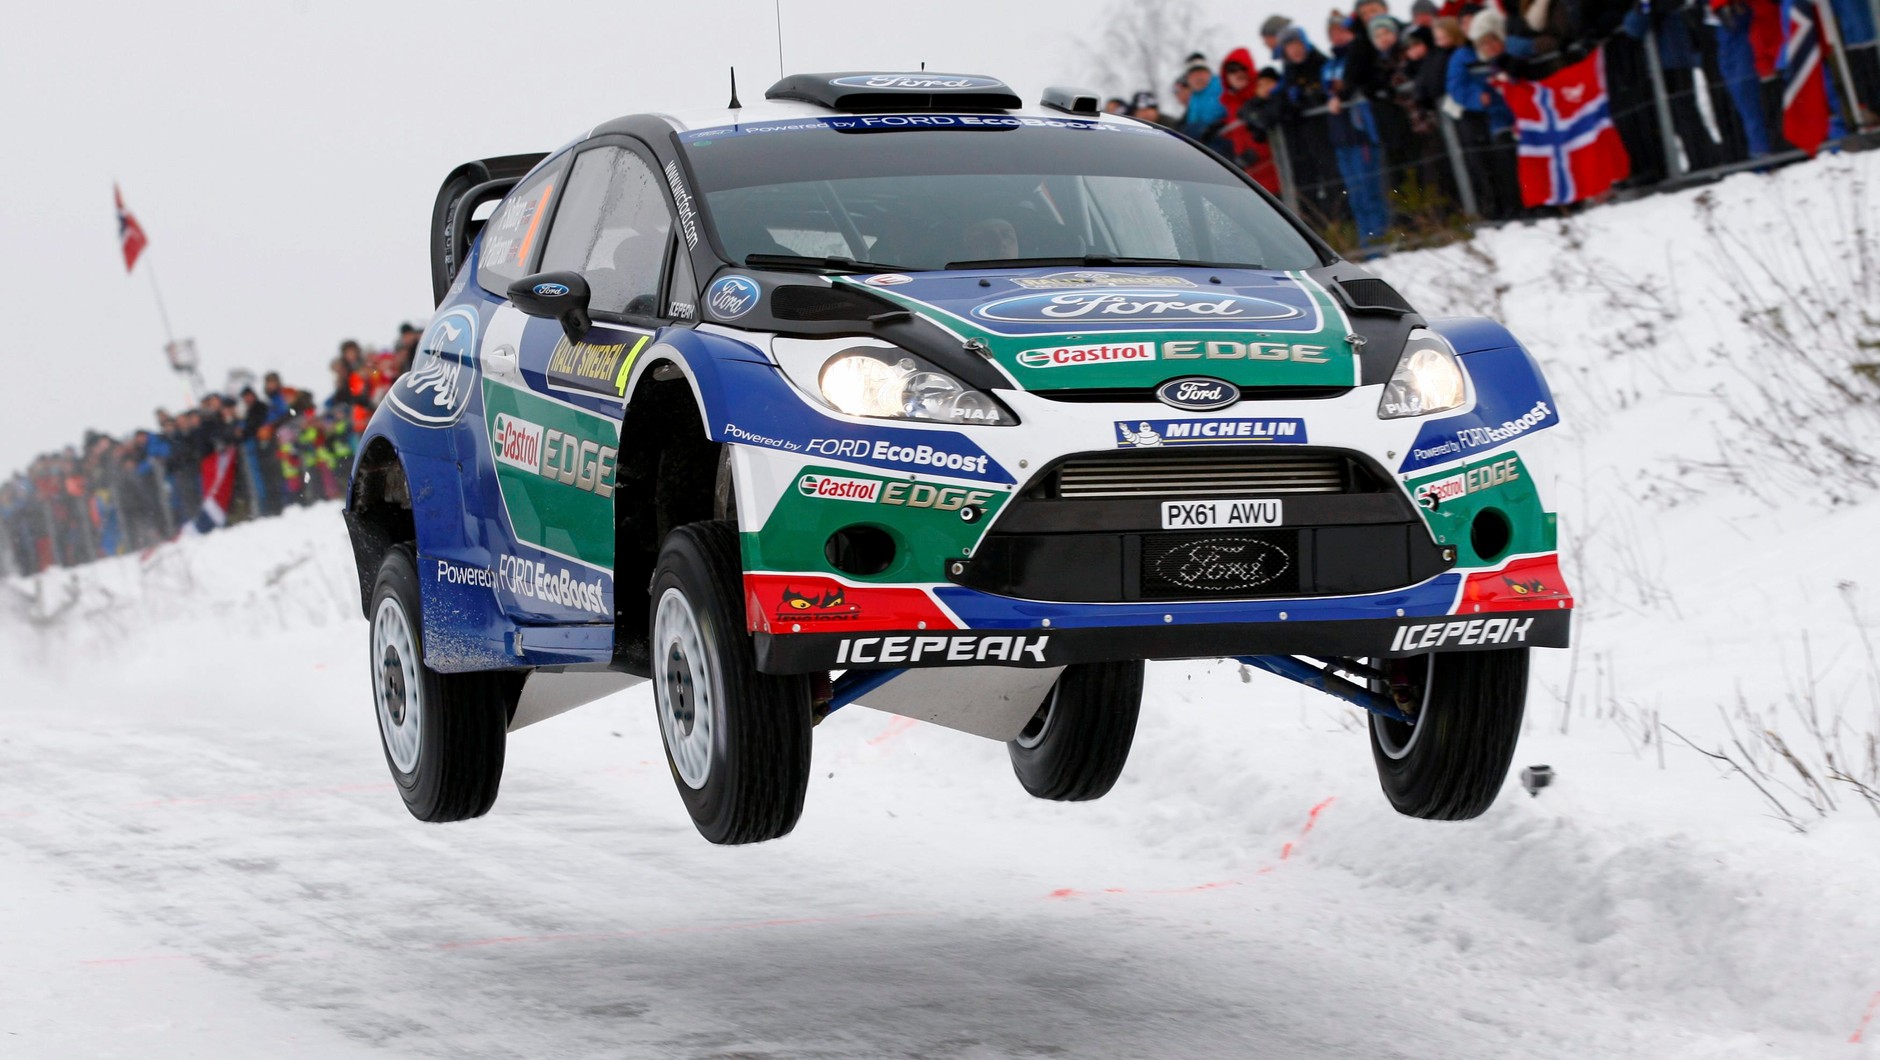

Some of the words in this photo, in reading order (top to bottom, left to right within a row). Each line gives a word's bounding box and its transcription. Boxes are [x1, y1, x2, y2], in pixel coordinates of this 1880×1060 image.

[865, 75, 973, 88] Ford
[745, 122, 829, 134] Powered
[833, 118, 856, 129] by
[860, 115, 954, 127] FORD
[957, 116, 1121, 132] EcoBoost
[664, 159, 699, 252] www.wrcford.com
[538, 284, 564, 295] Ford
[712, 279, 751, 314] Ford
[1041, 293, 1244, 318] Ford
[668, 301, 696, 320] ICEPEAK
[406, 320, 464, 411] Ford
[550, 334, 587, 375] RALLY
[576, 341, 627, 382] SWEDEN
[614, 335, 650, 397] 4
[1053, 344, 1150, 365] Castrol
[1161, 339, 1332, 365] EDGE
[1176, 381, 1222, 401] Ford
[949, 407, 1001, 421] PIAA
[1165, 421, 1297, 437] MICHELIN
[1414, 440, 1452, 461] Powered
[1451, 438, 1461, 454] by
[1456, 427, 1490, 449] FORD
[1487, 400, 1552, 443] EcoBoost
[503, 420, 540, 468] Castrol
[541, 428, 619, 499] EDGE
[723, 422, 783, 448] Powered
[784, 439, 802, 452] by
[805, 437, 871, 459] FORD
[871, 440, 989, 475] EcoBoost
[1466, 456, 1520, 494] EDGE
[817, 477, 877, 501] Castrol
[879, 480, 996, 515] EDGE
[1167, 503, 1217, 526] PX61
[1227, 502, 1277, 525] AWU
[1179, 545, 1267, 583] Ford
[437, 559, 491, 588] Powered
[499, 553, 535, 598] FORD
[534, 561, 609, 616] EcoBoost
[835, 634, 1050, 664] ICEPEAK
[1389, 617, 1535, 652] ICEPEAK
